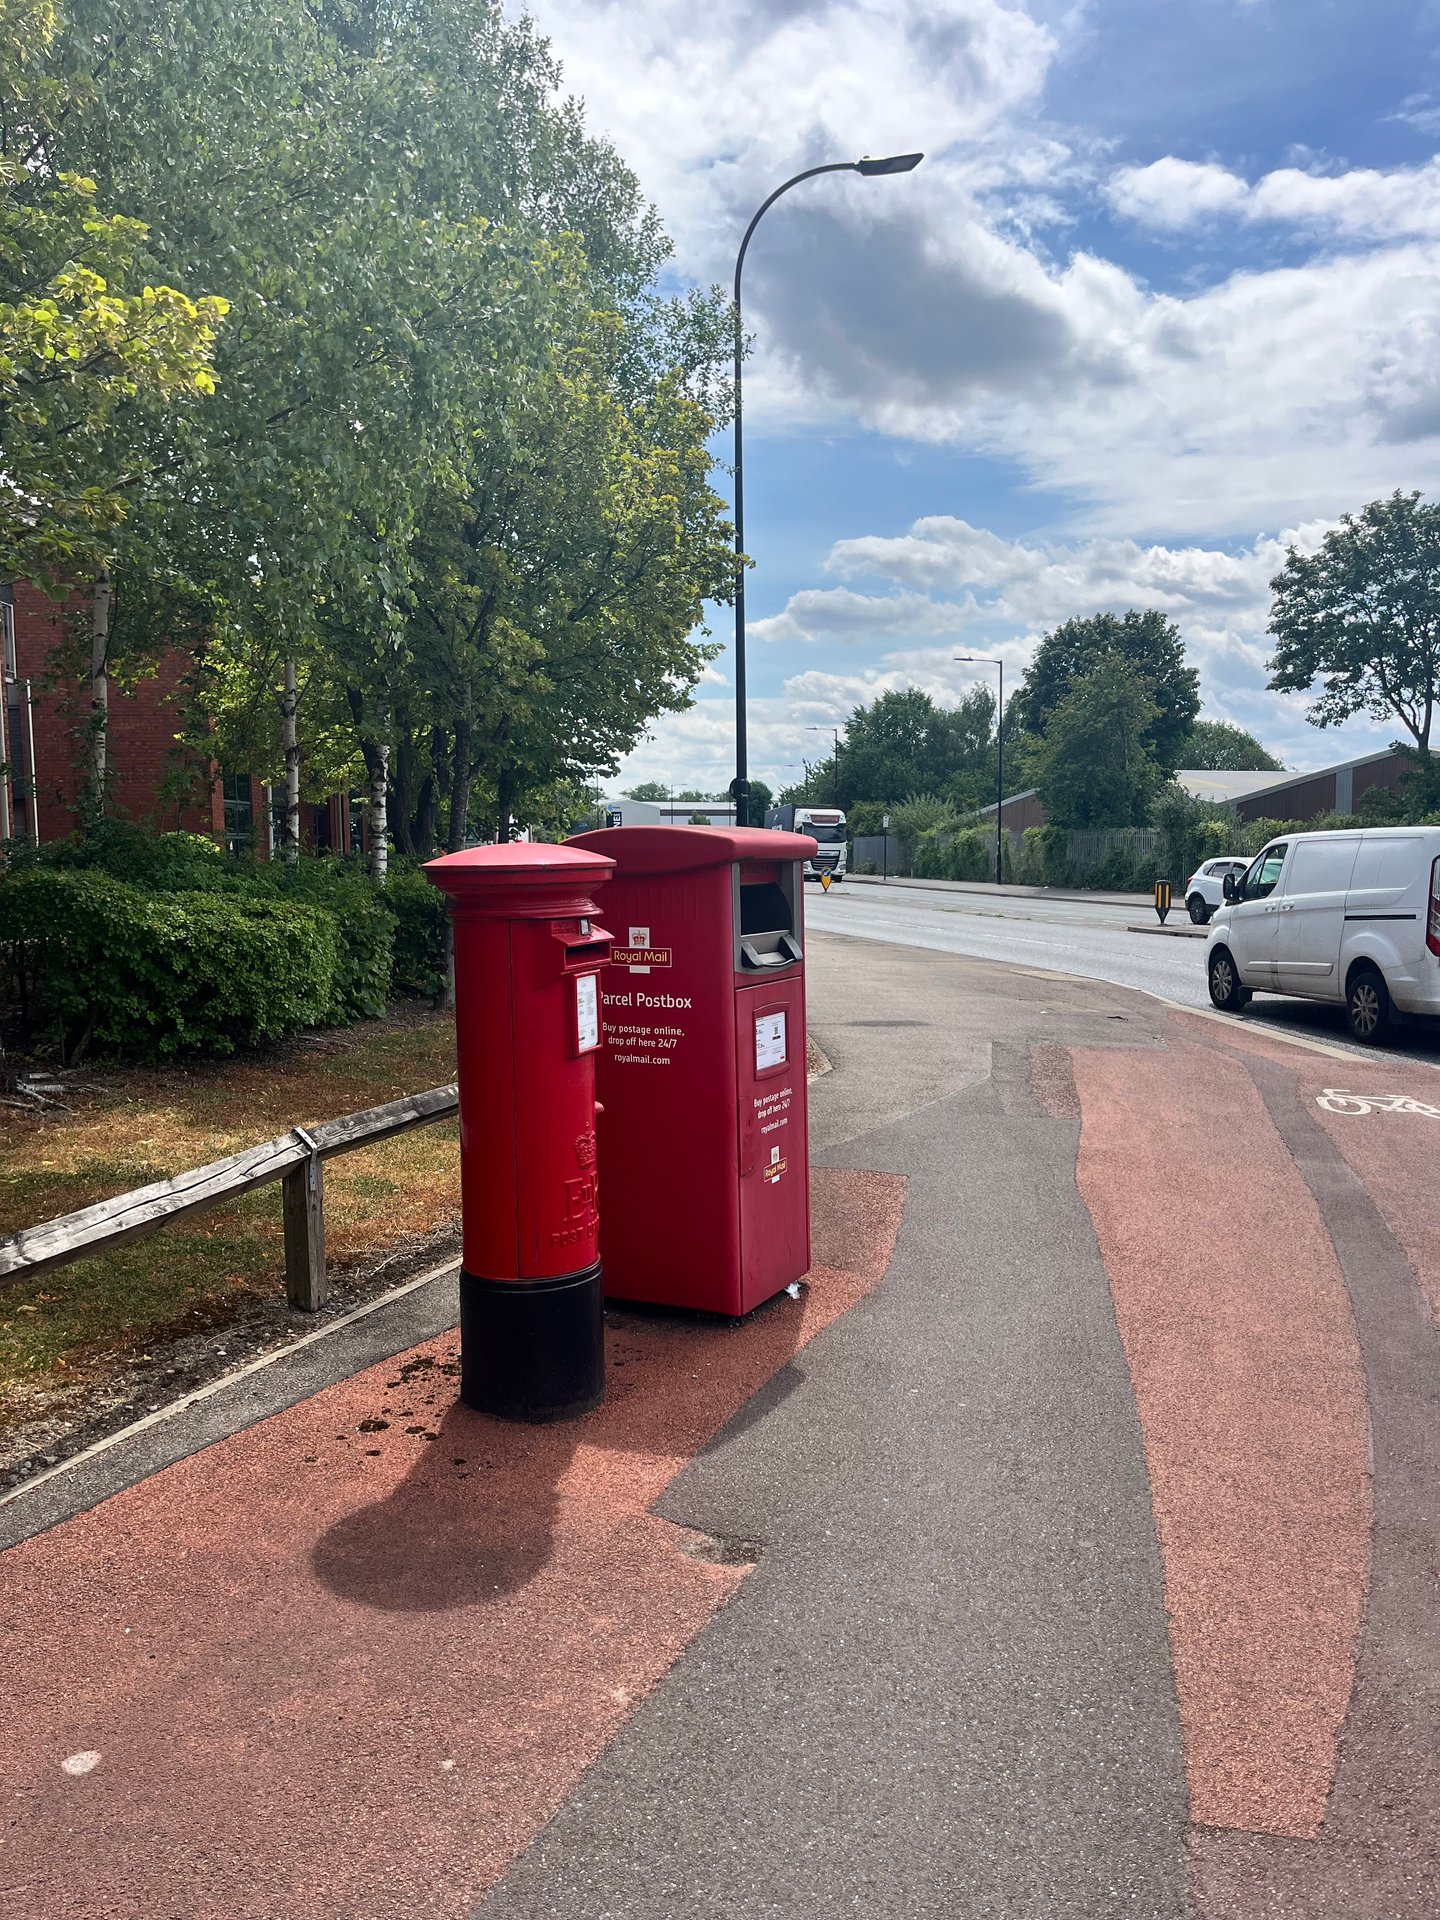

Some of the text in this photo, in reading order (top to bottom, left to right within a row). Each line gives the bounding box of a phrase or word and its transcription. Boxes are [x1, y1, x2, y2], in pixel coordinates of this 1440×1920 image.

[614, 950, 667, 963] Royal Mail
[637, 992, 692, 1008] Postbox
[602, 1022, 685, 1036] Buy postage online,
[608, 1036, 677, 1048] drop off here 24/7
[614, 1053, 671, 1065] royalmail.com
[754, 1099, 762, 1108] Buy
[763, 1093, 779, 1105] postage
[758, 1110, 766, 1118] drop
[773, 1104, 781, 1113] here
[761, 1118, 788, 1134] royalmail.com
[765, 1160, 786, 1177] Royal Mail
[551, 1226, 584, 1247] POST
